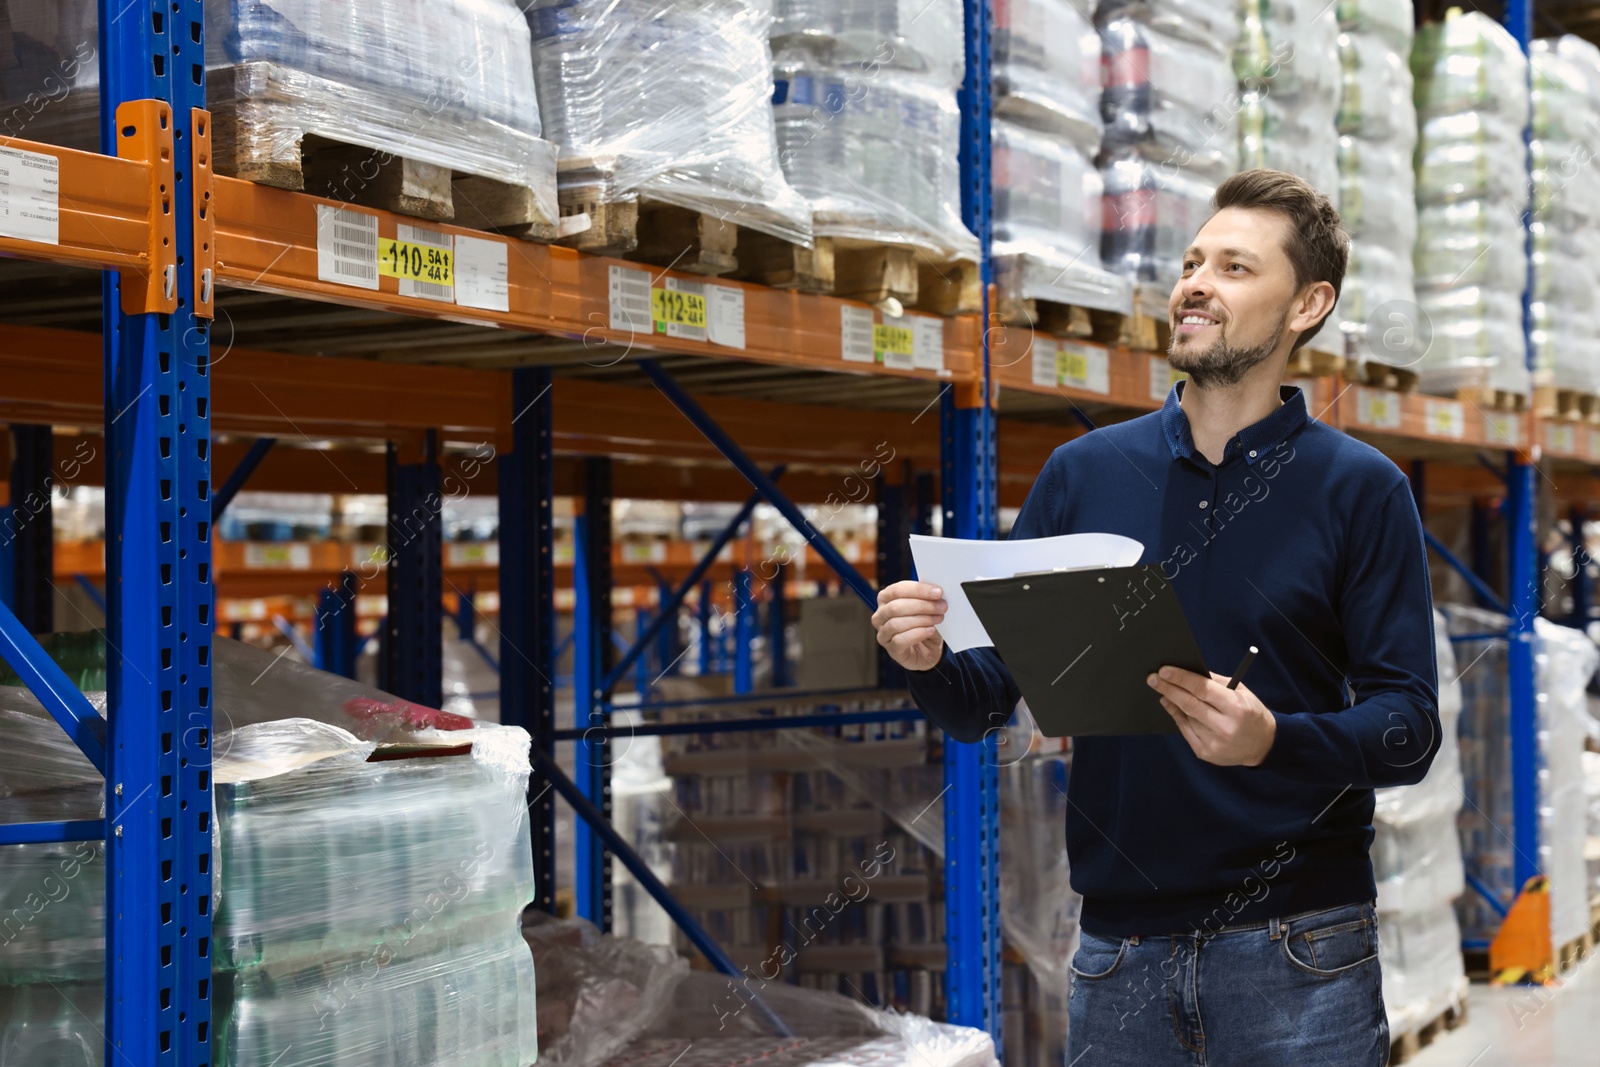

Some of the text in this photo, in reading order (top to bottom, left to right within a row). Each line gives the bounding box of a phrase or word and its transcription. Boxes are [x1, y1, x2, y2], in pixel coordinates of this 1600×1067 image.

[428, 249, 442, 266] 5A
[428, 265, 442, 281] 4A
[687, 295, 698, 309] 5A
